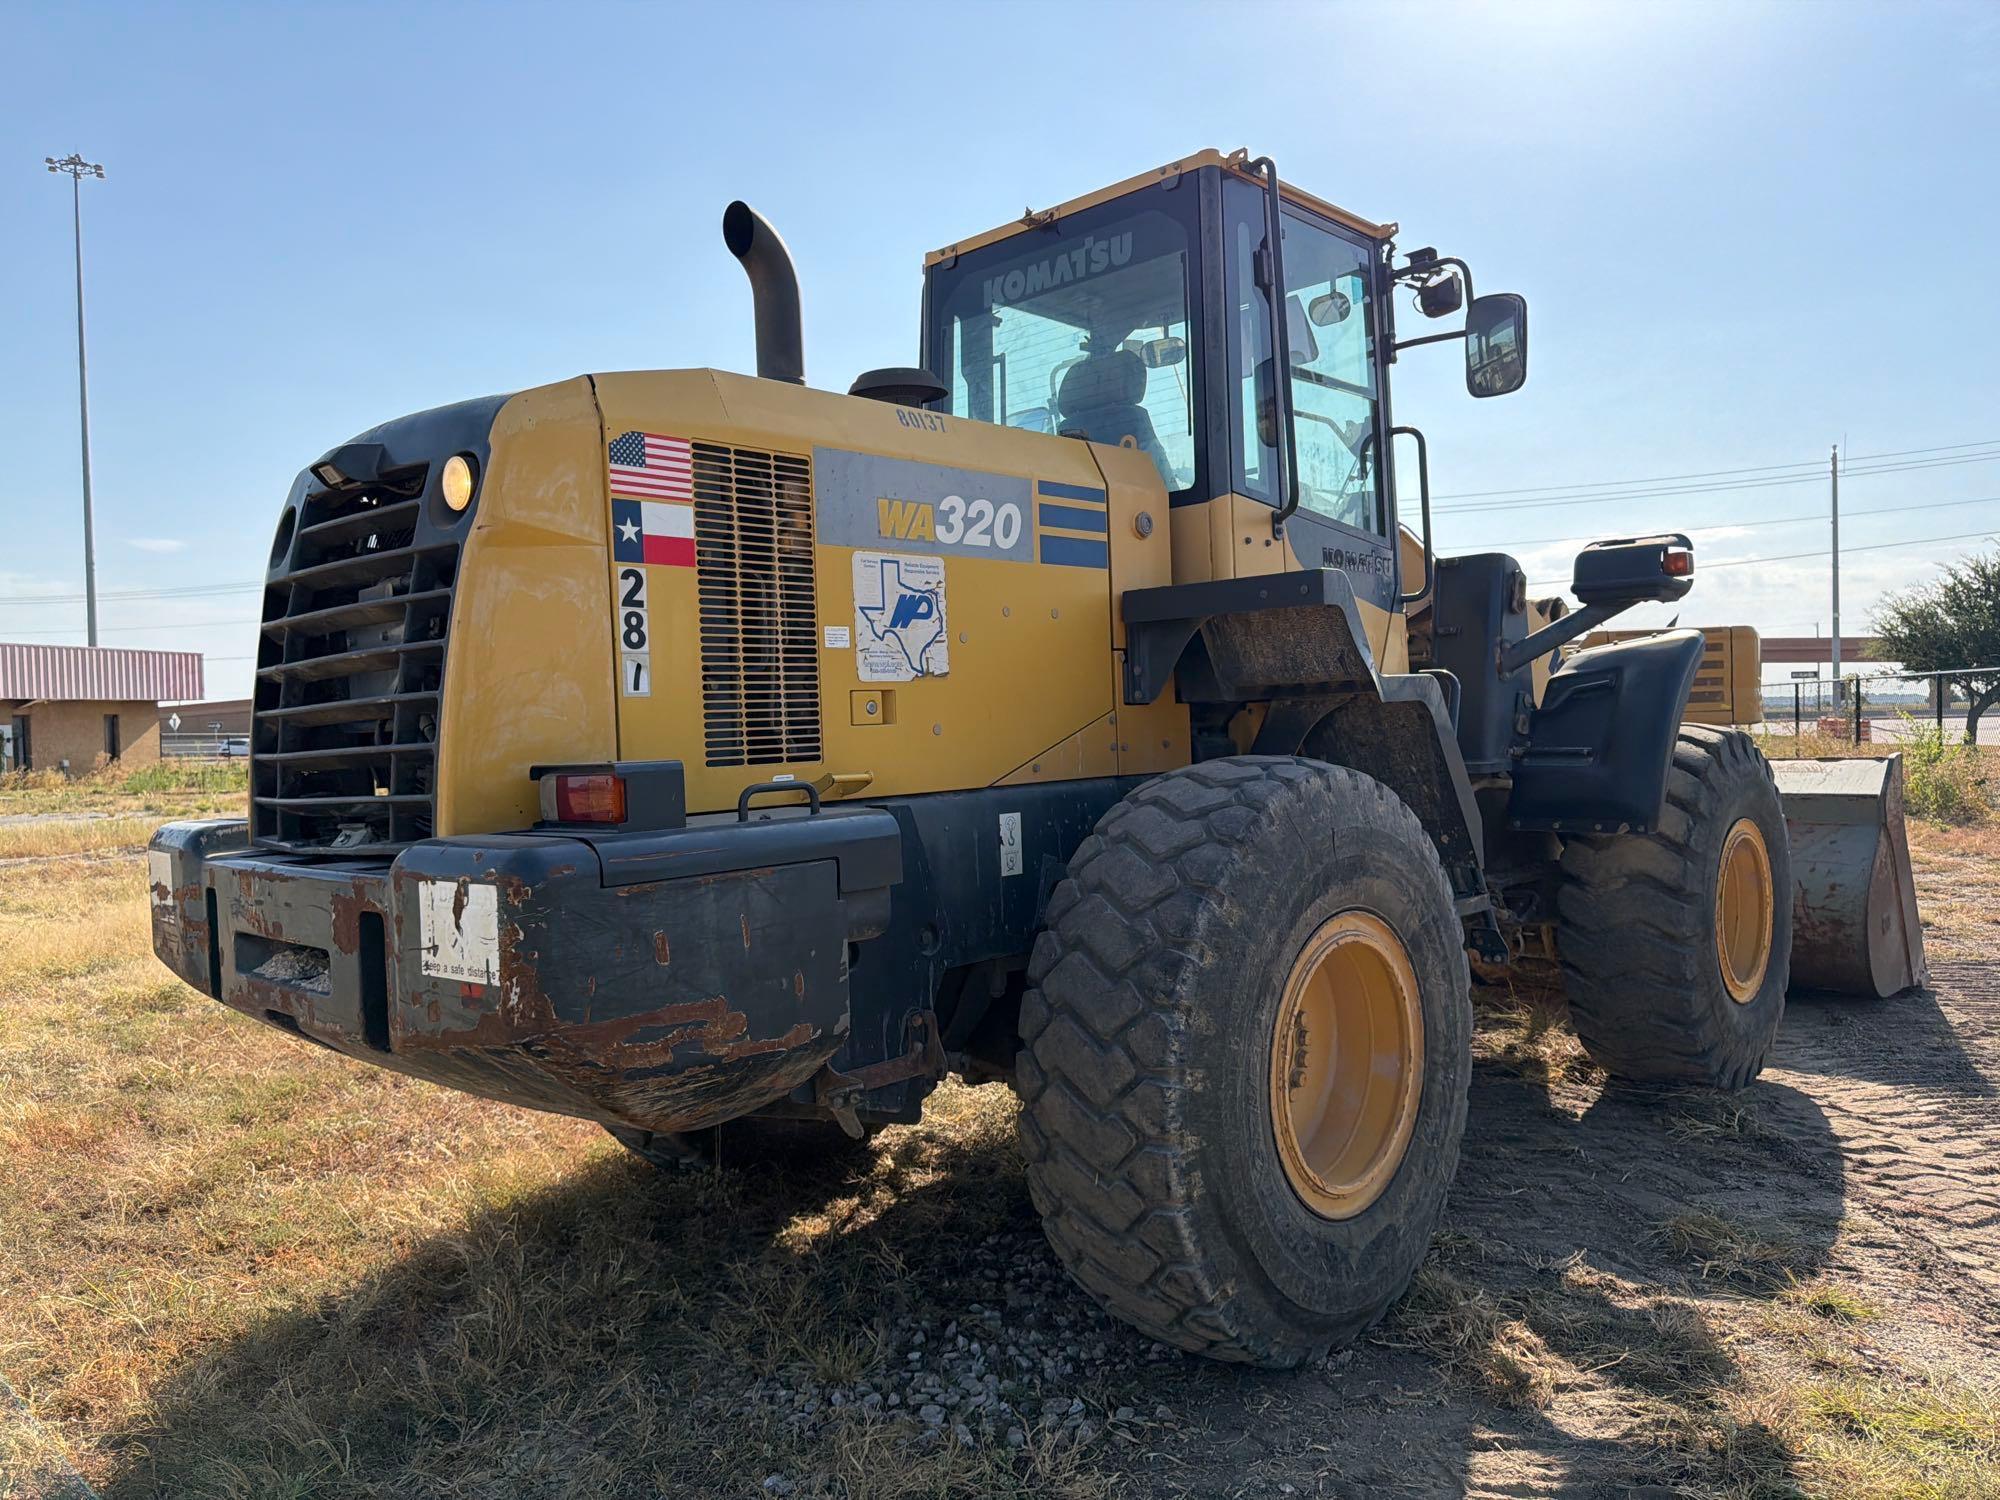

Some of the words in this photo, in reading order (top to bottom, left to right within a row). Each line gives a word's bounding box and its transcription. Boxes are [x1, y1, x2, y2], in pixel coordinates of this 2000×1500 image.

[984, 232, 1133, 309] KOMATSU
[896, 408, 945, 433] 80137
[877, 494, 1022, 550] WA320
[1322, 547, 1392, 578] KOMATSU
[444, 964, 448, 973] a
[451, 965, 465, 975] safe
[468, 966, 497, 980] distae
